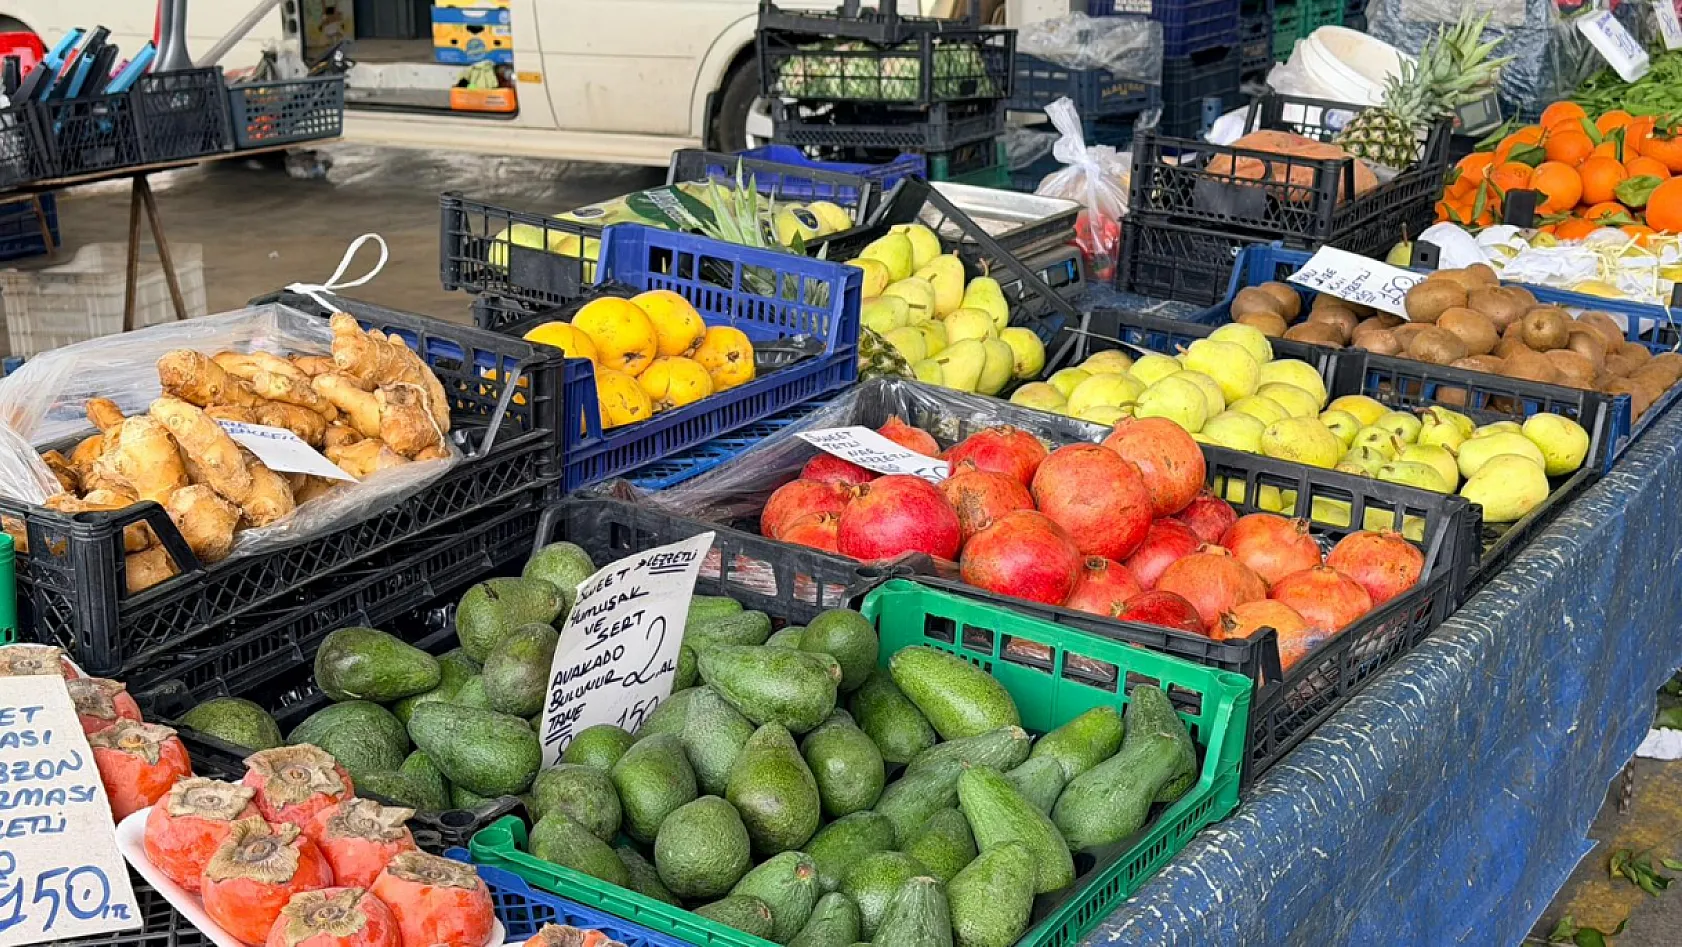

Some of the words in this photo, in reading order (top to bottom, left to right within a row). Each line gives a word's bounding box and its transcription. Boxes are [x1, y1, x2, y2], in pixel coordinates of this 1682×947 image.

[576, 567, 630, 607] SWEET
[584, 617, 606, 635] VE
[592, 609, 646, 645] SERT
[551, 645, 625, 690] AVAKADO
[622, 615, 666, 687] 2
[548, 669, 623, 713] BULUNUR
[0, 706, 44, 726] ET
[0, 729, 51, 748] ASI
[0, 750, 83, 784] BZON
[0, 786, 97, 809] RMASI
